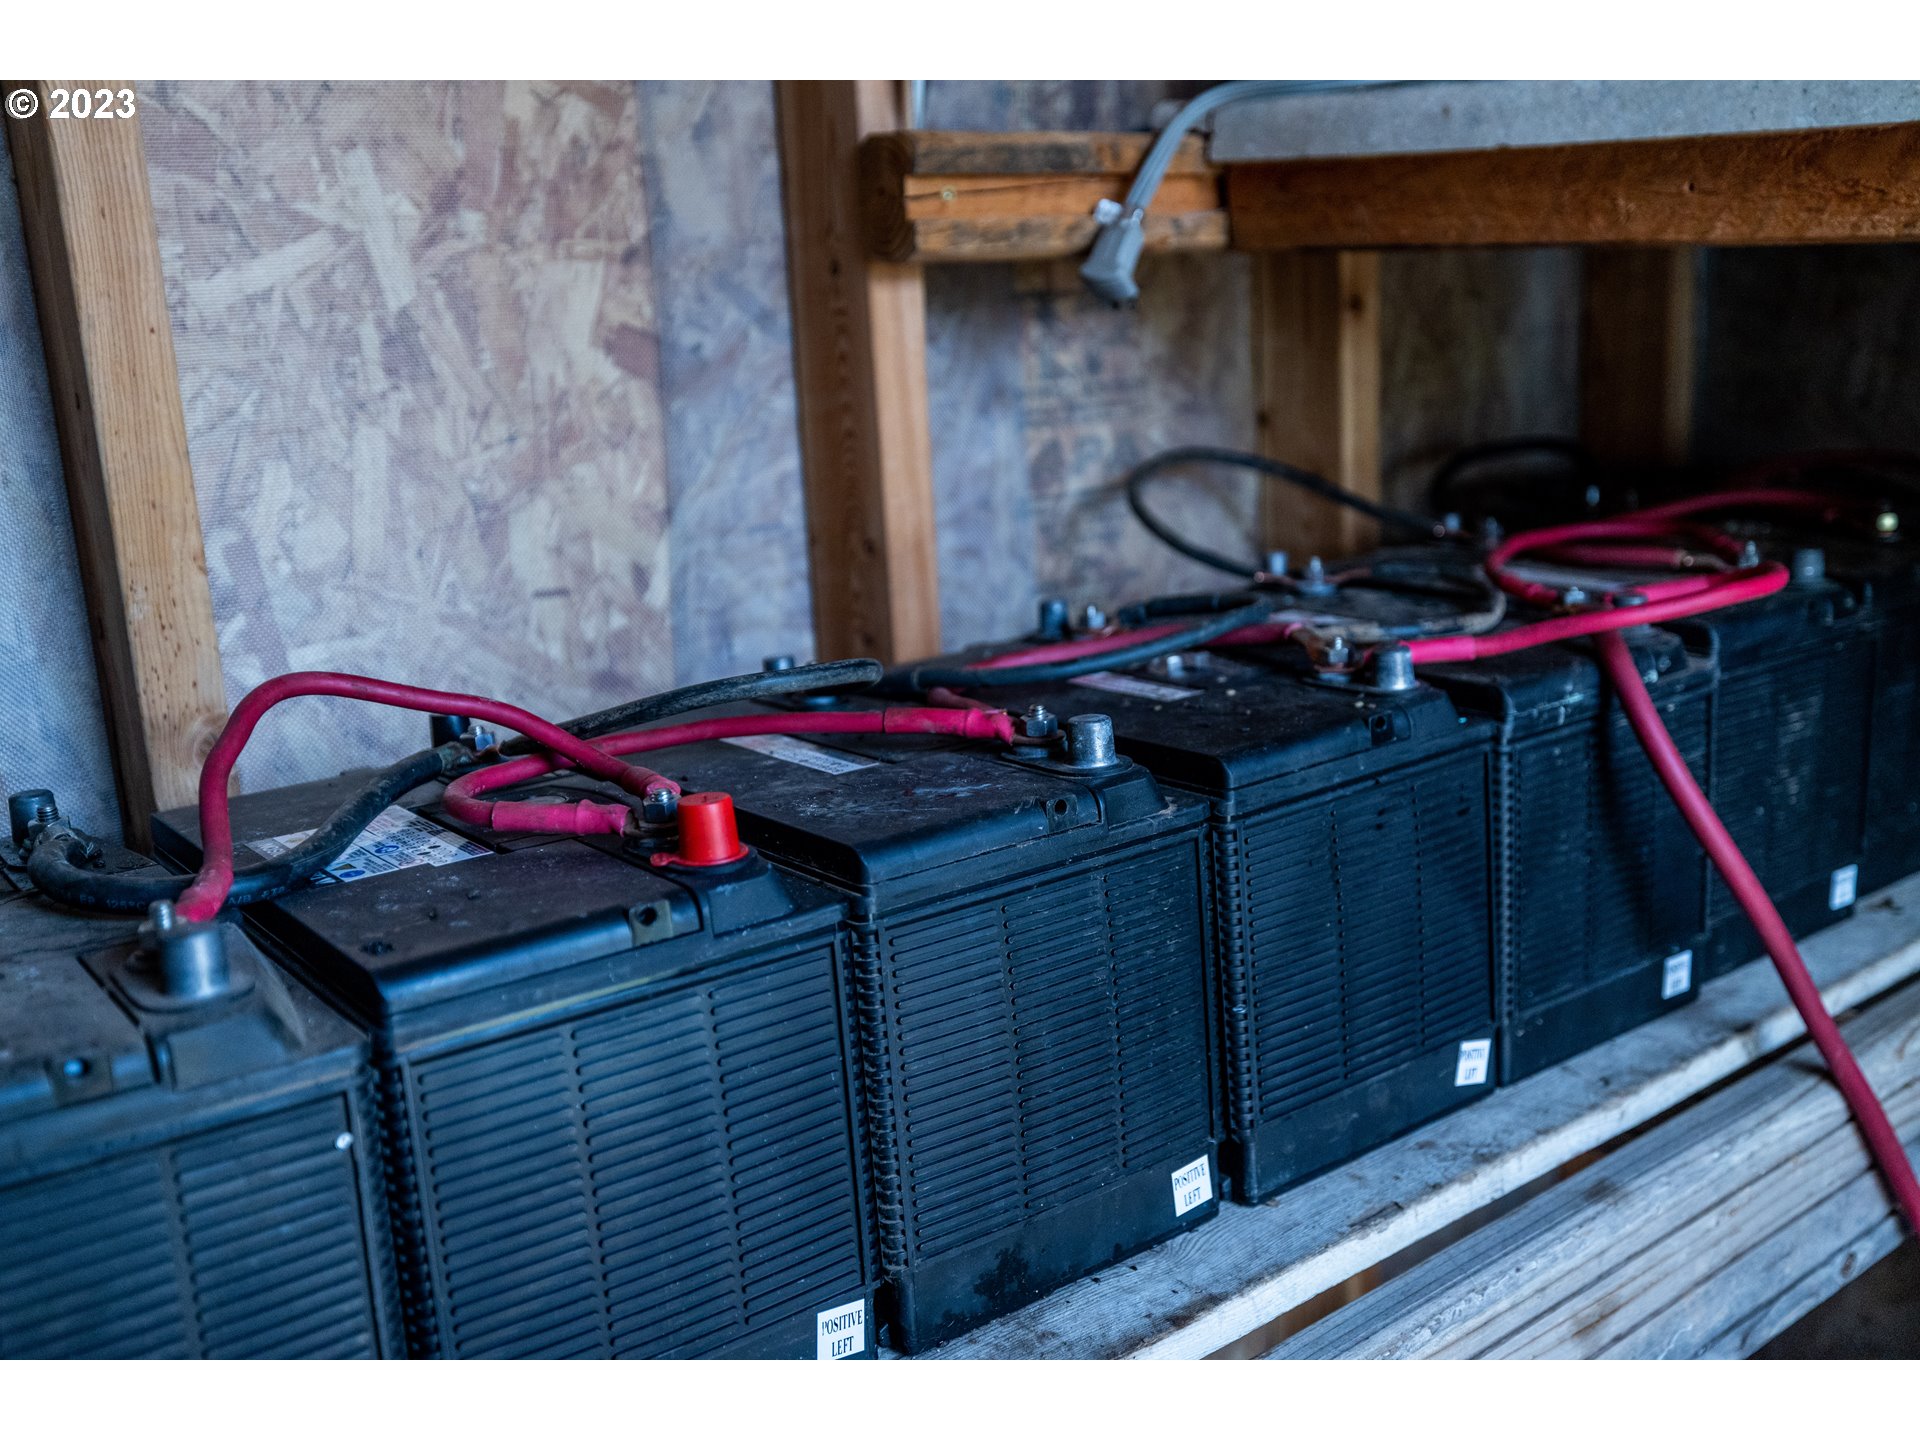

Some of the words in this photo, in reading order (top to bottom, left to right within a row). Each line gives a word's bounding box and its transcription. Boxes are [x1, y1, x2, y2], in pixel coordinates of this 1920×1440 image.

[1184, 1186, 1201, 1207] LEFT
[821, 1309, 863, 1337] POSITIVE
[831, 1335, 854, 1357] LEFT
